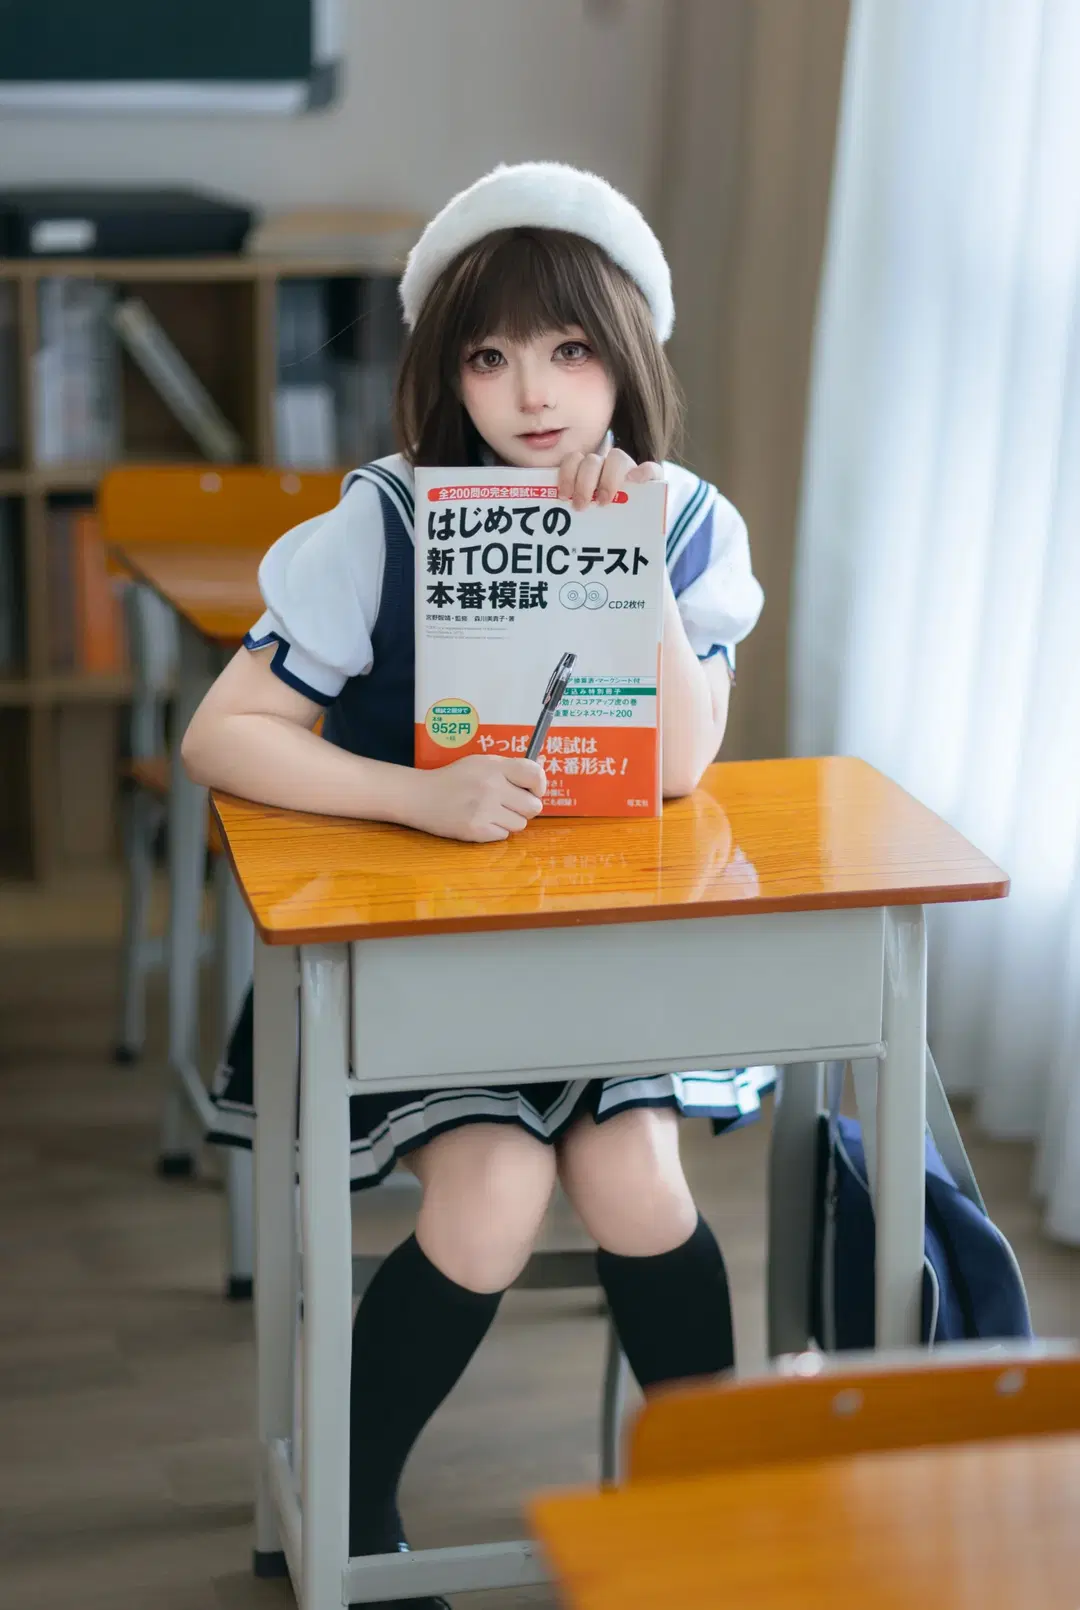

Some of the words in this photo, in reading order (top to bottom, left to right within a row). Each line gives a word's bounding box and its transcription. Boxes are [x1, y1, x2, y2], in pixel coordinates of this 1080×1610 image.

[427, 506, 572, 541] はじめての
[426, 581, 548, 610] 本番模試
[608, 599, 646, 610] CD2枚付
[432, 722, 471, 735] 952円
